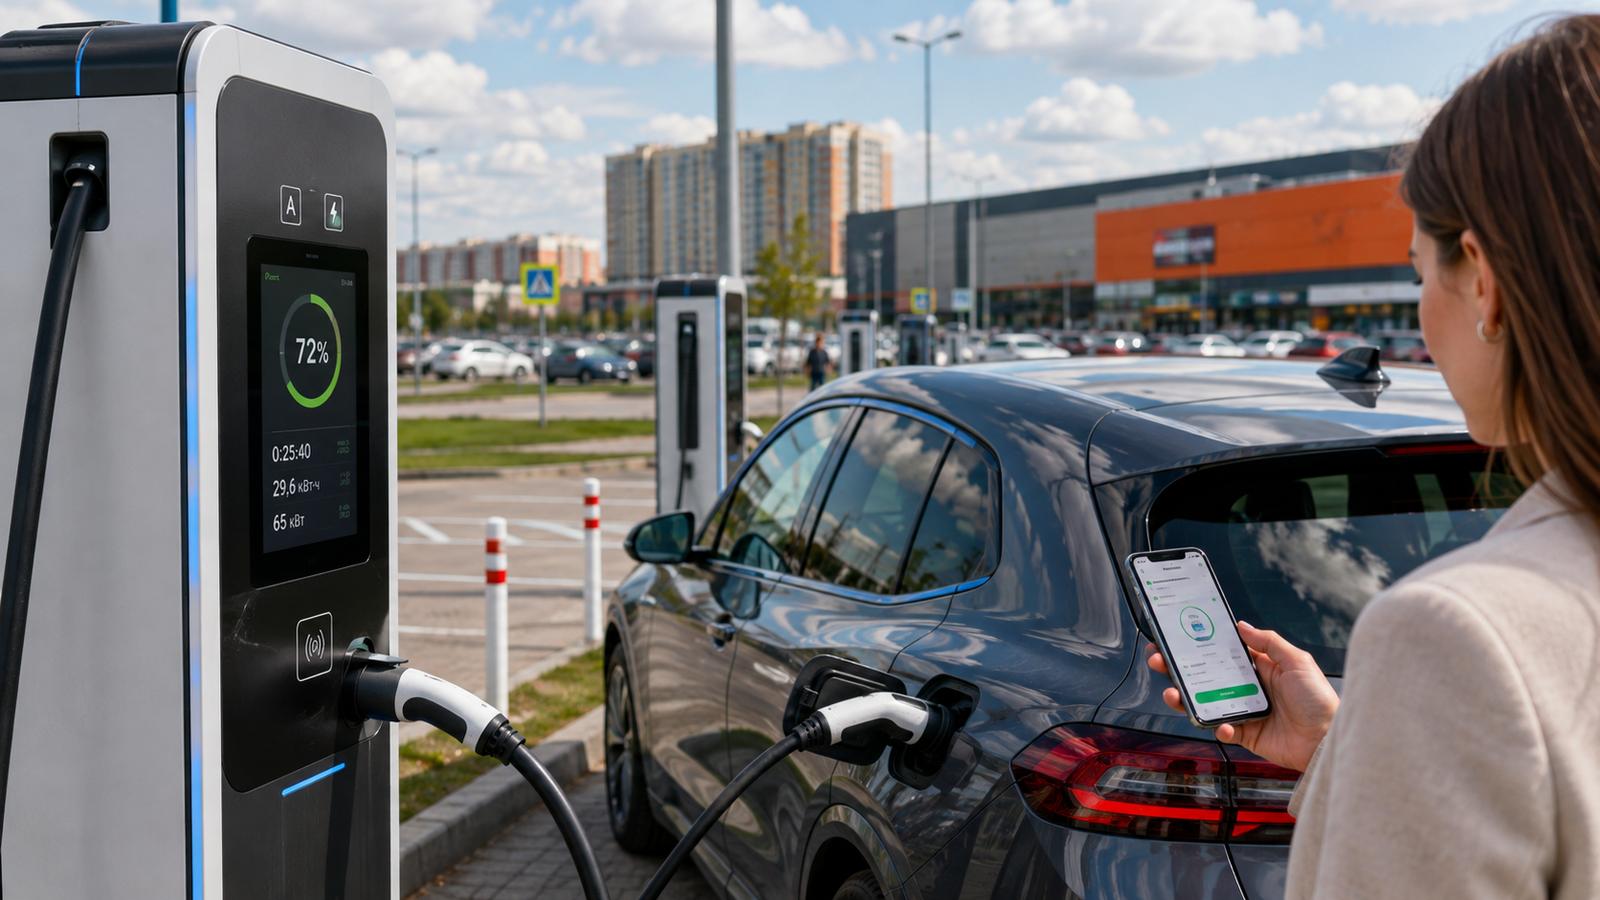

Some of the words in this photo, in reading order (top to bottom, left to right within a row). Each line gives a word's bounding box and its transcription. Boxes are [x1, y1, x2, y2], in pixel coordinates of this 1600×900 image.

[285, 195, 297, 217] A
[295, 337, 329, 364] 72%
[271, 442, 312, 463] 0:25:40
[272, 478, 296, 498] 29,6
[272, 513, 287, 532] 65
[289, 514, 305, 529] кВт
